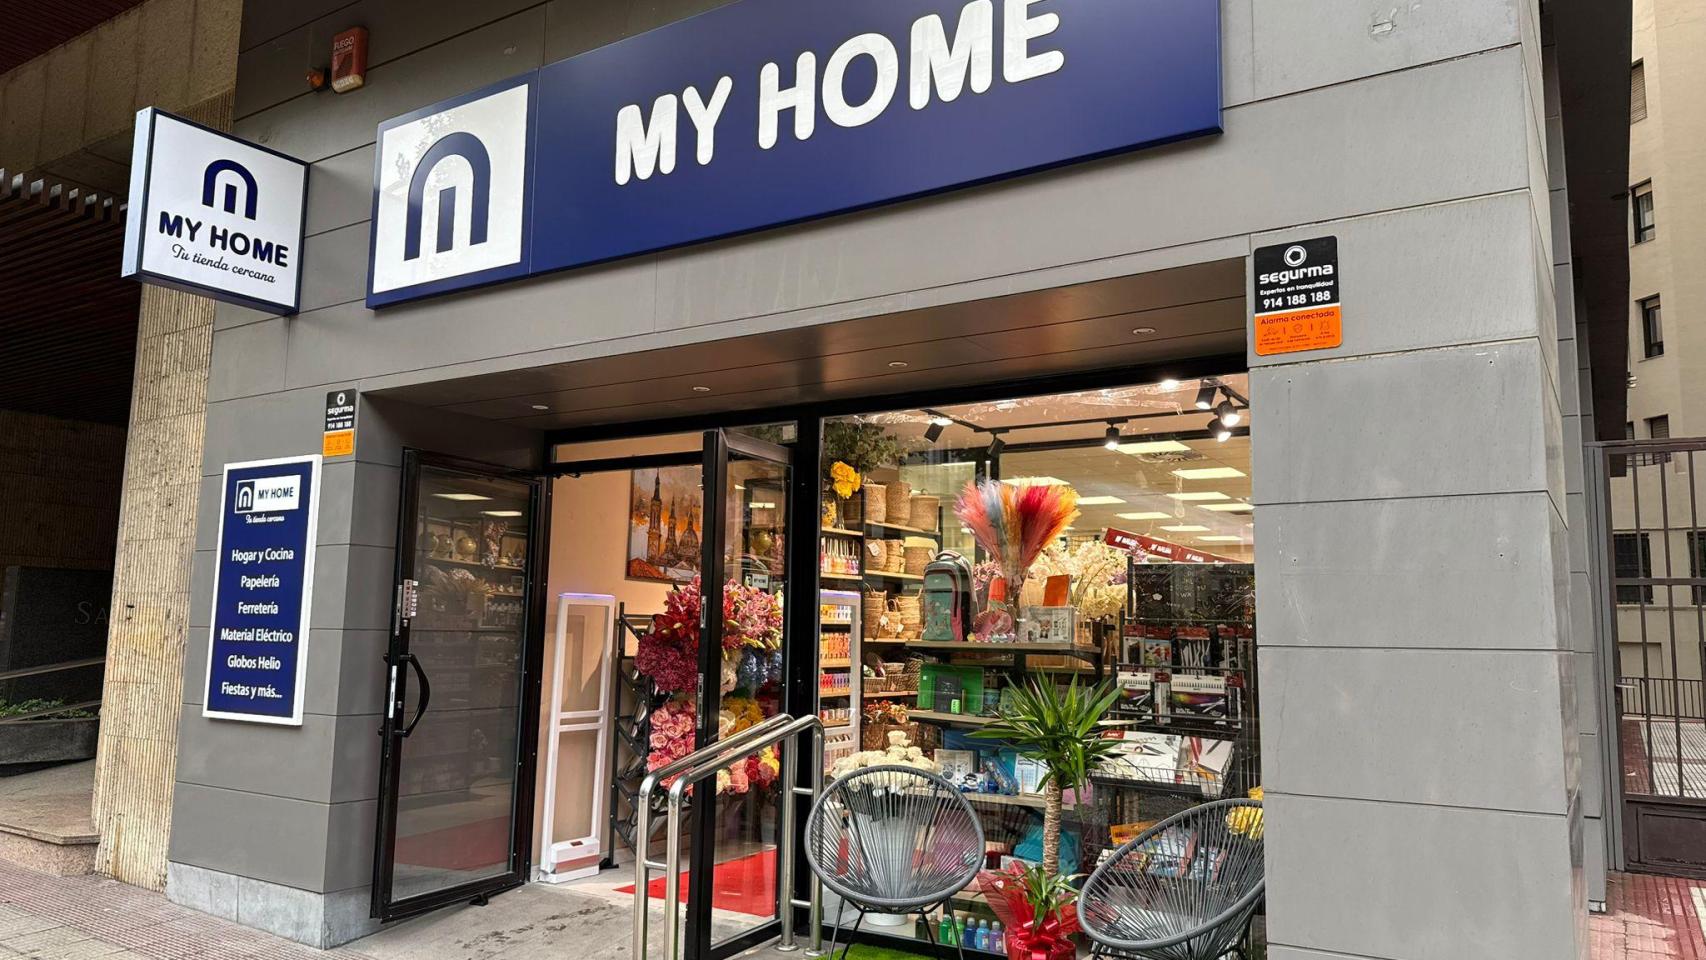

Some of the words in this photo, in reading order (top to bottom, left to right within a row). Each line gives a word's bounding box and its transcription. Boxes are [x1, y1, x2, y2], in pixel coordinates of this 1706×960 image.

[614, 75, 733, 186] MY
[758, 0, 1065, 149] HOME
[159, 211, 202, 242] MY
[209, 225, 289, 267] HOME
[172, 244, 190, 260] Tu
[192, 253, 230, 271] tienda
[231, 264, 275, 283] cercana
[1259, 264, 1333, 285] segurma
[1263, 297, 1283, 309] 914
[1286, 294, 1307, 306] 188
[1310, 291, 1331, 303] 188
[1260, 317, 1289, 325] Alarma
[1291, 311, 1335, 321] conectada
[258, 489, 269, 500] MY
[270, 486, 294, 499] HOME
[231, 548, 257, 564] Hogar
[257, 551, 264, 564] y
[265, 546, 294, 560] Cocina
[240, 574, 280, 590] Papelería
[238, 600, 279, 615] Ferretería
[220, 627, 256, 642] Material
[256, 627, 293, 642] Eléctrico
[227, 654, 257, 669] Globos
[257, 656, 281, 670] Helio
[221, 682, 250, 695] Fiestas
[250, 685, 257, 699] y
